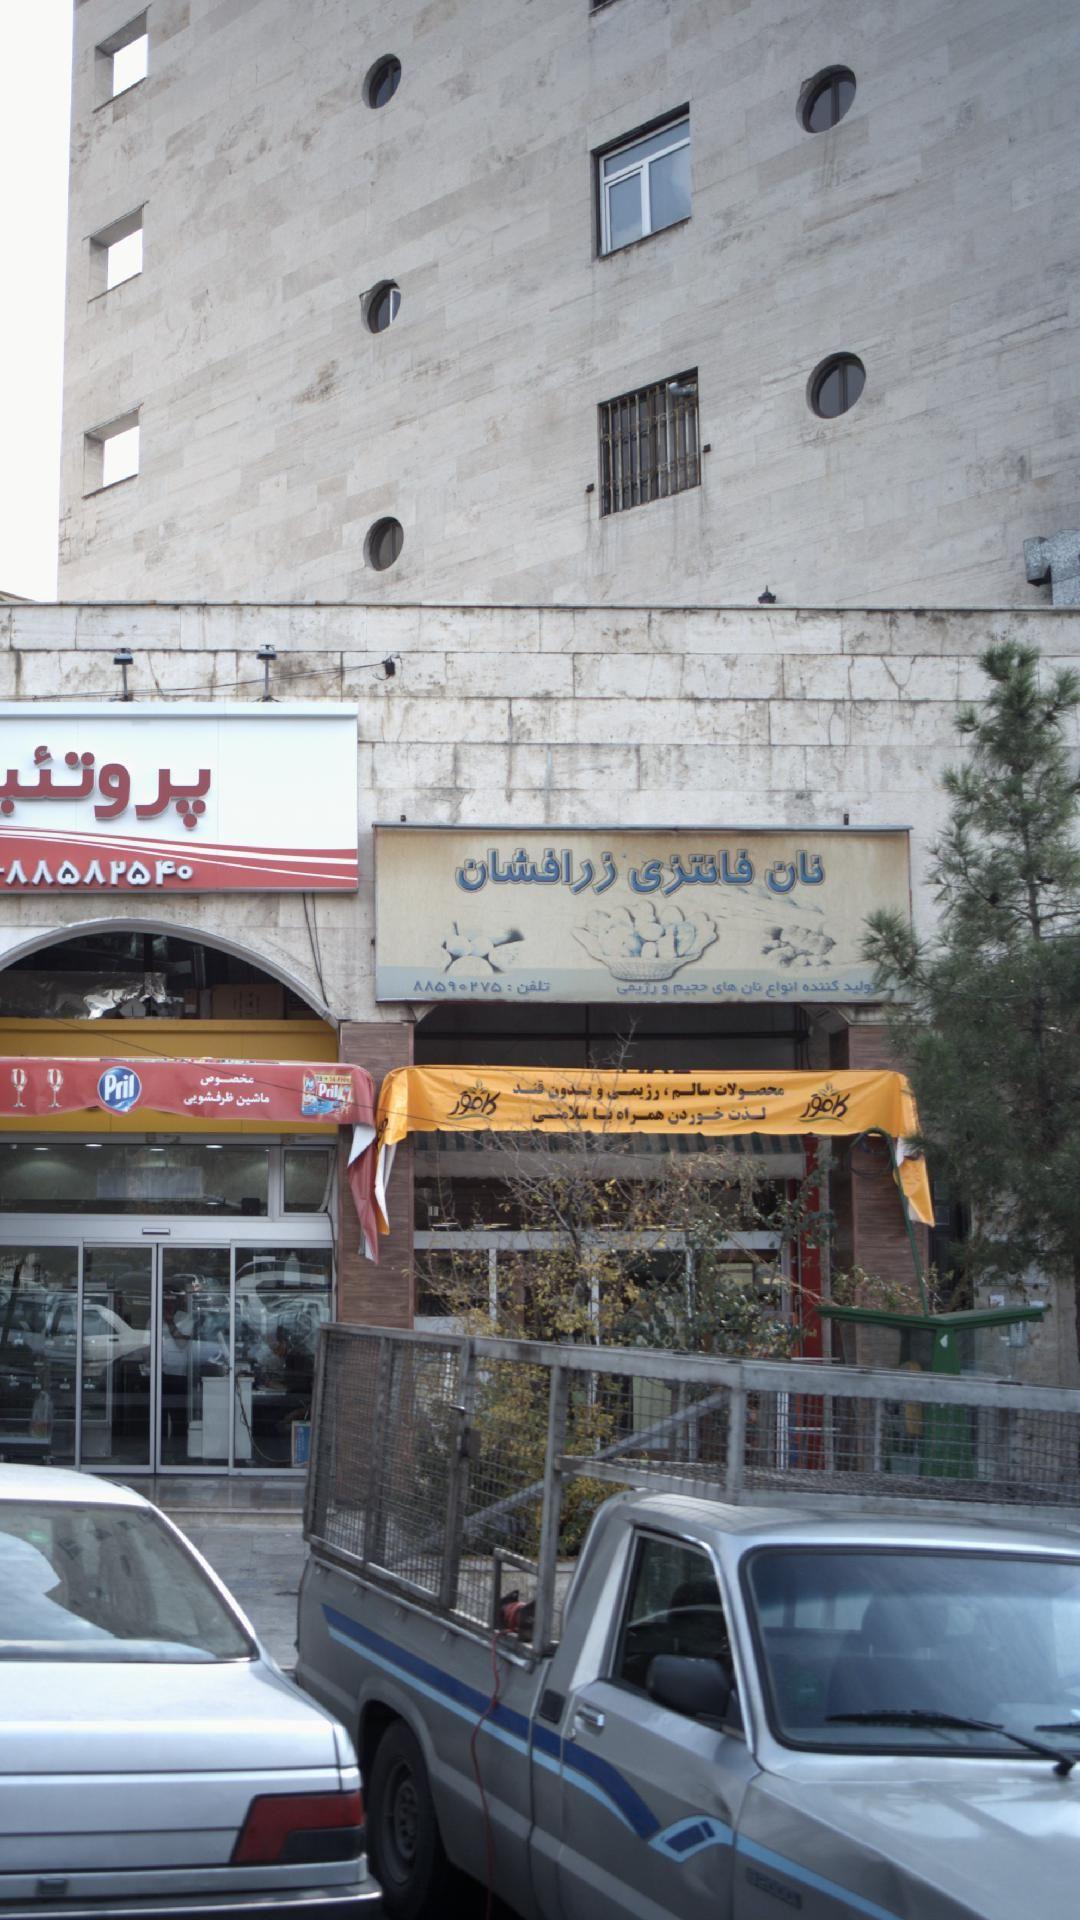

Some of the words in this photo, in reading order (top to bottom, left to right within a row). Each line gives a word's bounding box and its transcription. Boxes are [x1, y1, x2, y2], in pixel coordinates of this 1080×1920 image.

[455, 848, 618, 895] زرافشان
[628, 849, 754, 897] فانتزی
[765, 849, 826, 894] نان
[517, 980, 550, 994] تلفن
[616, 982, 657, 995] رژیمی
[661, 984, 669, 996] و
[673, 983, 708, 996] حجیم
[713, 981, 737, 995] های
[741, 981, 762, 995] نان
[766, 981, 798, 997] انواع
[802, 980, 840, 993] کننده
[104, 1074, 135, 1101] Pril
[200, 1074, 255, 1086] مخصوص
[513, 1080, 544, 1094] قند
[319, 1083, 339, 1097] Pril
[548, 1084, 591, 1100] بدون
[597, 1088, 604, 1100] و
[608, 1083, 660, 1100] رژیمی
[672, 1083, 710, 1100] سالم
[714, 1083, 784, 1100] محصولات
[183, 1090, 234, 1107] ظرفشویی
[236, 1092, 270, 1107] ماشین
[593, 1107, 613, 1123] با
[617, 1107, 664, 1124] همراه
[667, 1107, 723, 1125] خوردن
[728, 1106, 766, 1120] لذت
